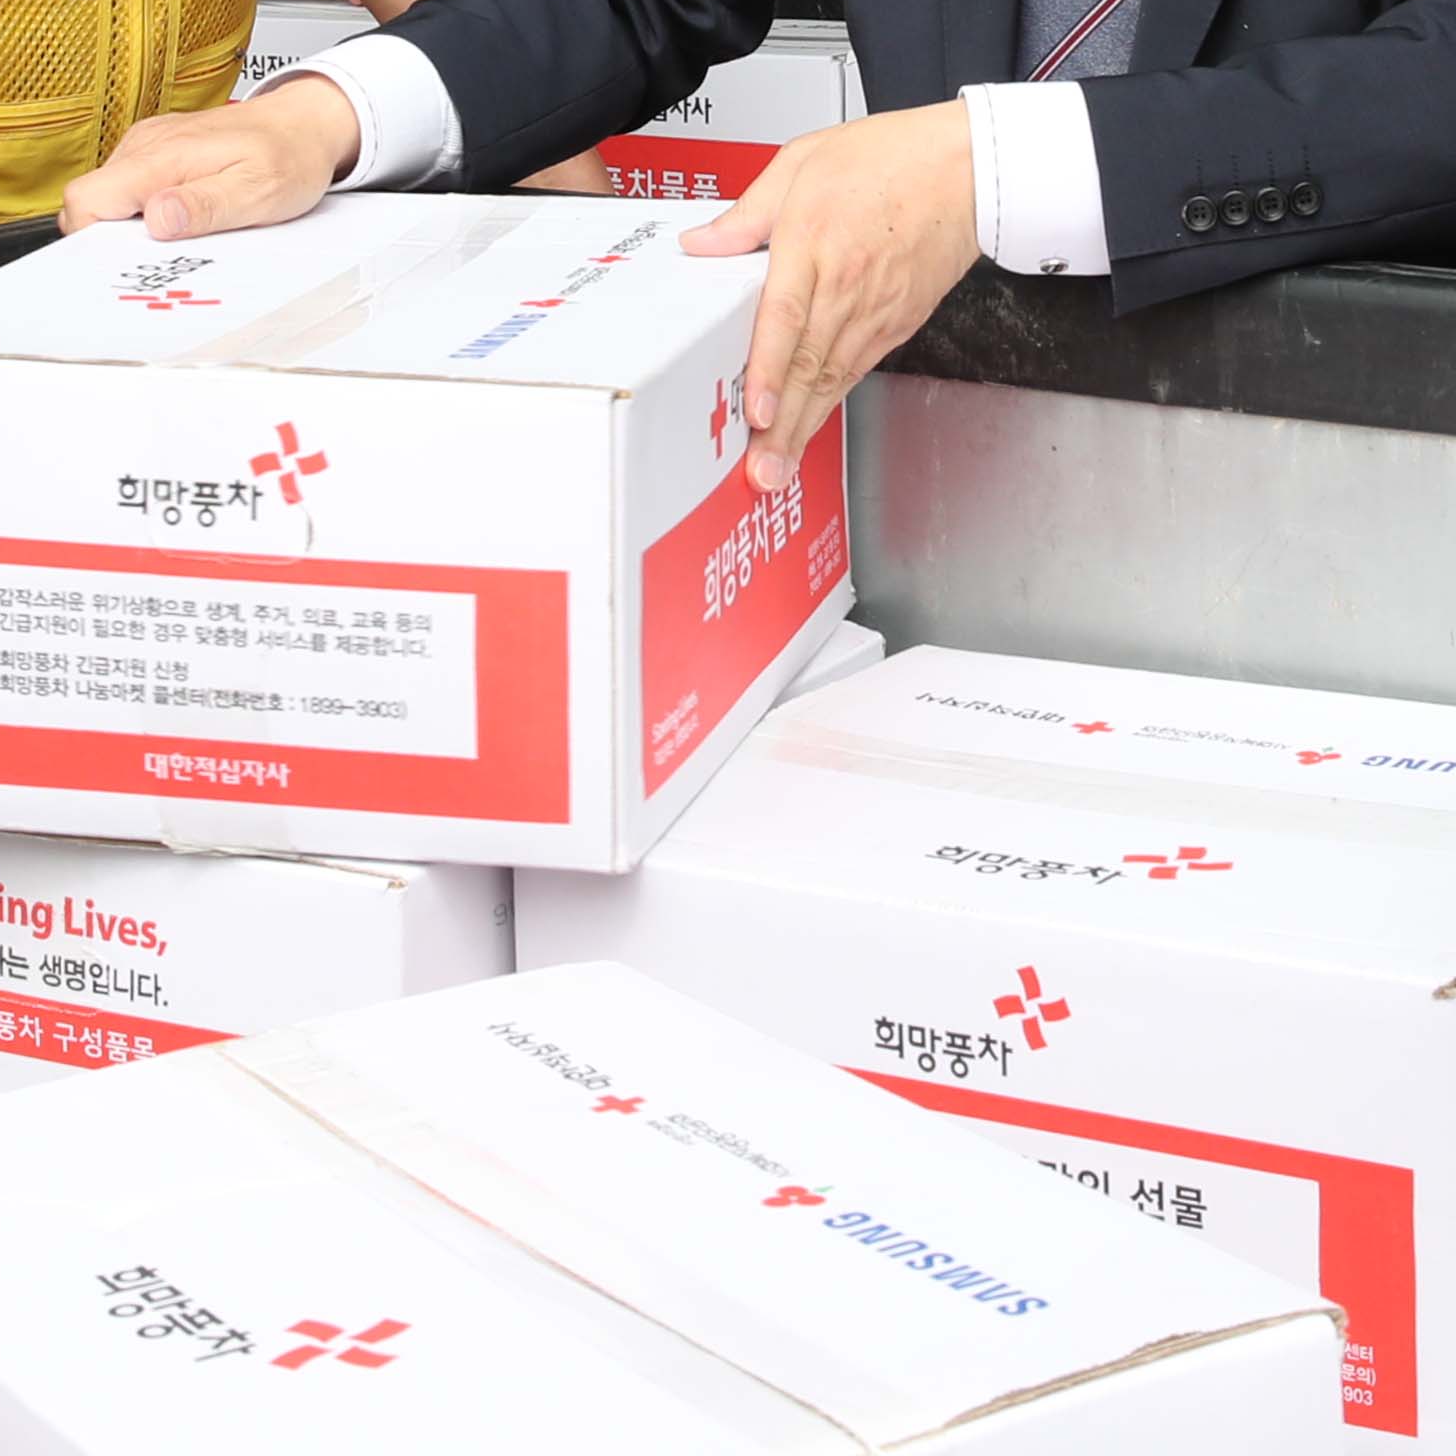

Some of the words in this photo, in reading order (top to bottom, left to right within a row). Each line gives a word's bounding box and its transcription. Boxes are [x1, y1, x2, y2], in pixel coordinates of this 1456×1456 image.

[117, 474, 264, 528] 희망풍차
[92, 592, 199, 619] 위기상황으로
[205, 601, 246, 624] 생계,
[351, 610, 387, 632] 교육
[397, 612, 433, 634] 등의
[92, 617, 146, 641] 필요한
[153, 622, 188, 644] 경우
[194, 626, 247, 649] 맞춤형
[255, 629, 327, 653] 서비스를
[334, 634, 433, 659] 제공합니다.
[0, 650, 69, 674] 희망풍차
[76, 655, 146, 679] 긴급지원
[153, 659, 189, 682] 신청
[75, 678, 146, 704] 나눔마켓
[916, 692, 1067, 725] 대한적십자사
[144, 752, 290, 788] 대한적십자사
[925, 845, 1127, 885] 희망풍차
[63, 895, 168, 956] Lives,
[39, 954, 169, 1007] 생명입니다.
[53, 1020, 157, 1065] 구성품목
[874, 1016, 1013, 1078] 희망풍차
[1131, 1178, 1208, 1230] 선물
[822, 1212, 1050, 1317] SAMSUNG
[96, 1264, 257, 1363] 희망풍차
